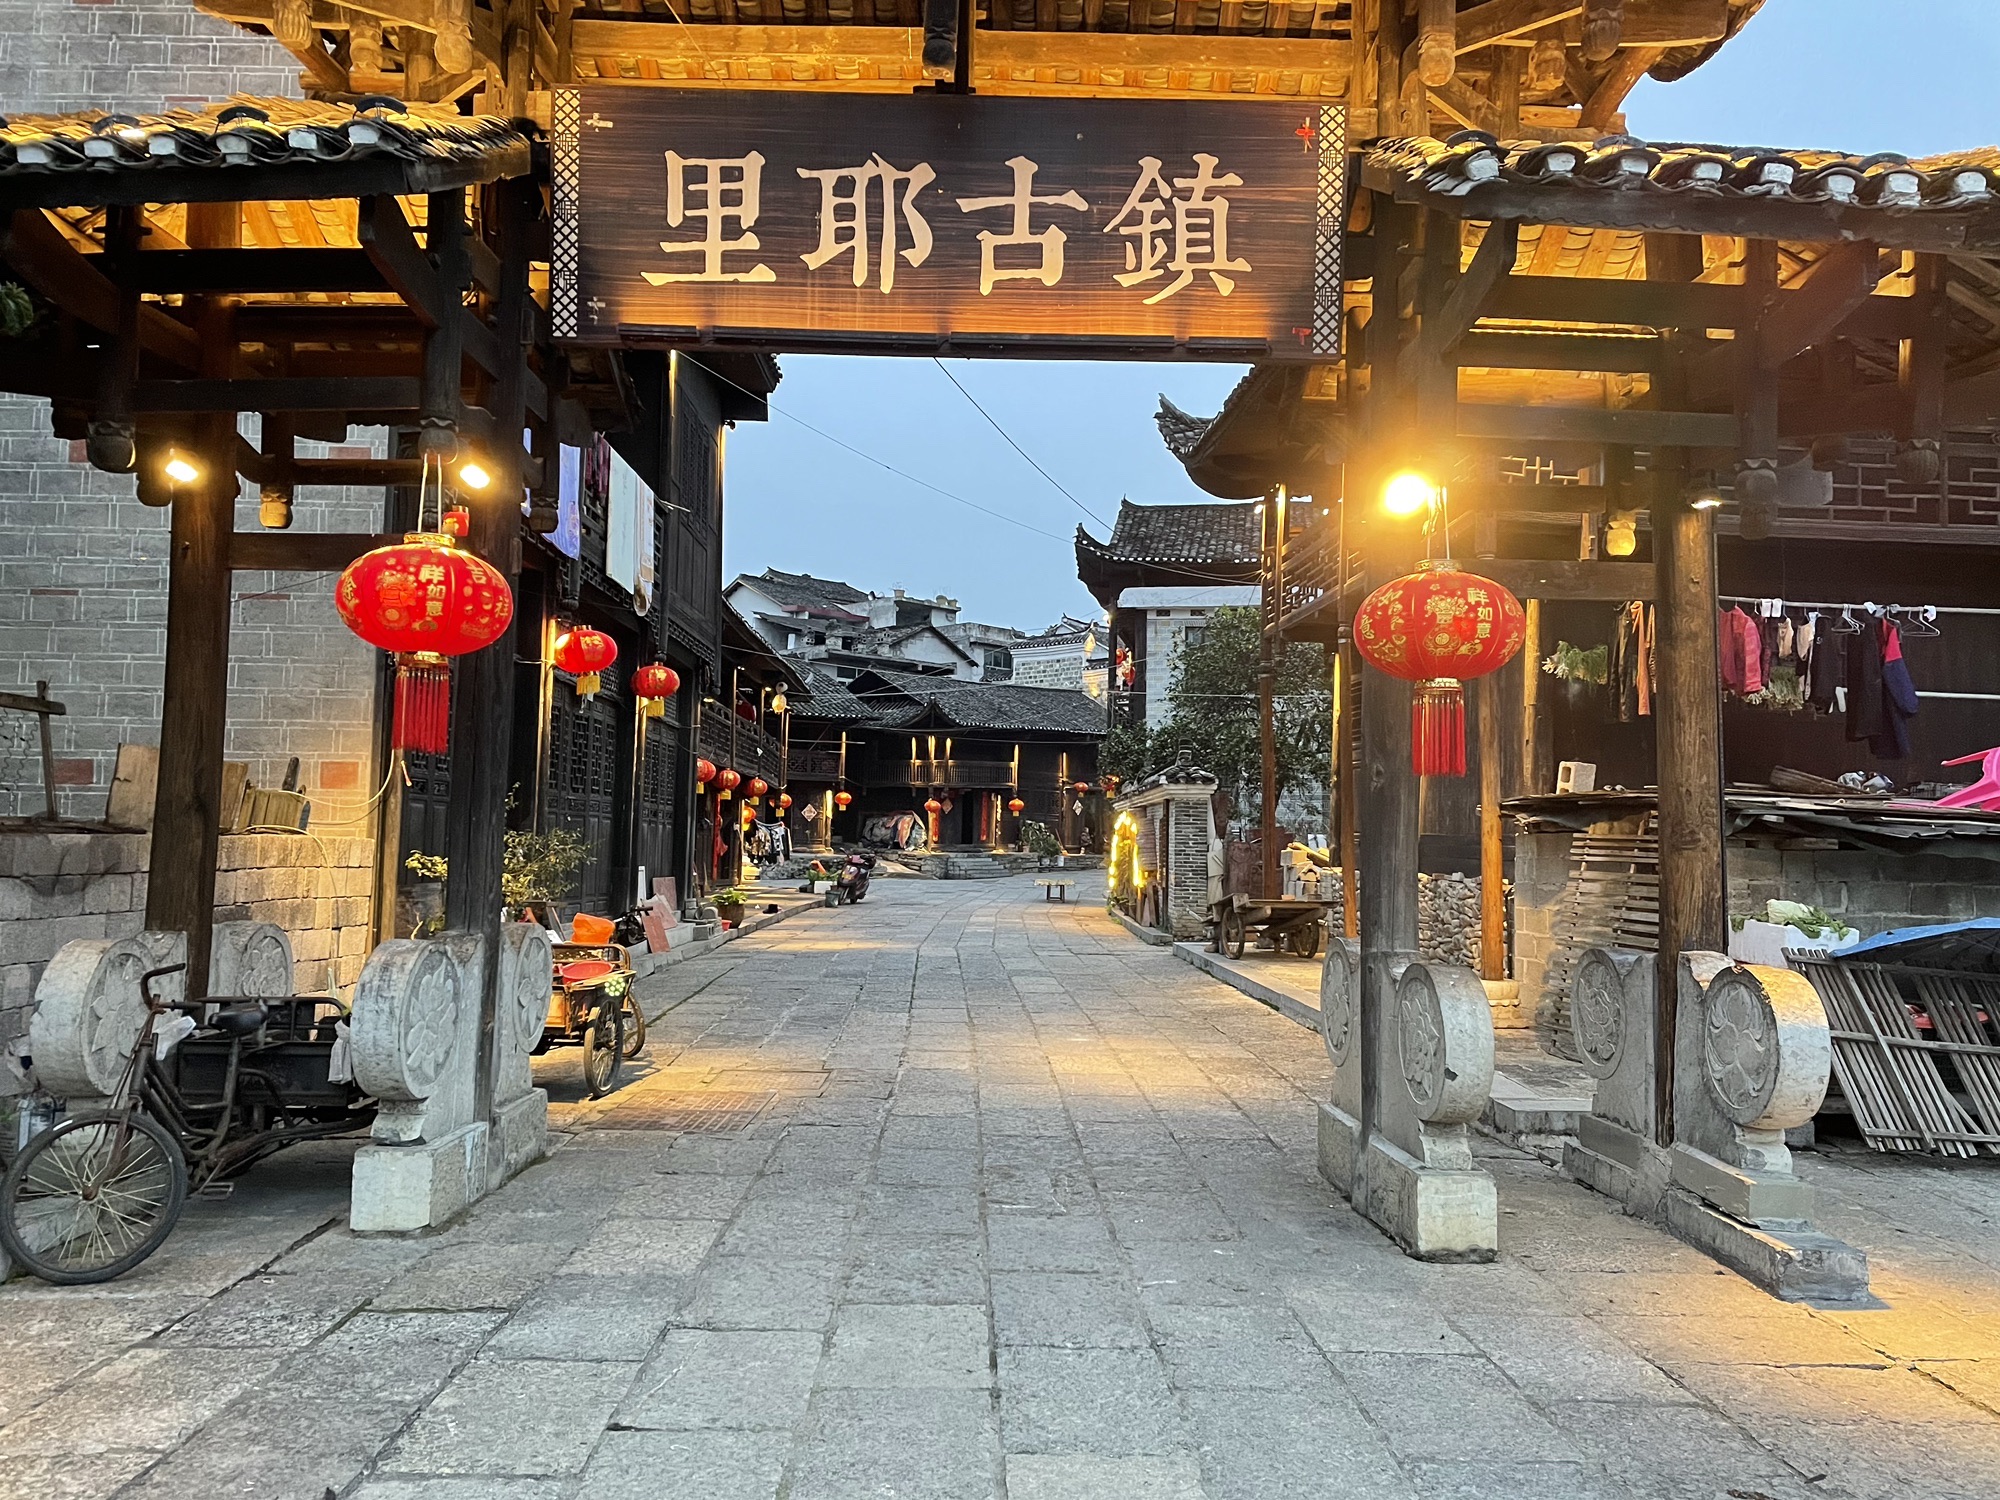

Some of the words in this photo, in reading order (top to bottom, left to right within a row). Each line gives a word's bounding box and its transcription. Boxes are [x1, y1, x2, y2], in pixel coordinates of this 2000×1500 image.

[640, 150, 1253, 305] 里耶古鎮
[1467, 587, 1493, 638] 祥如意
